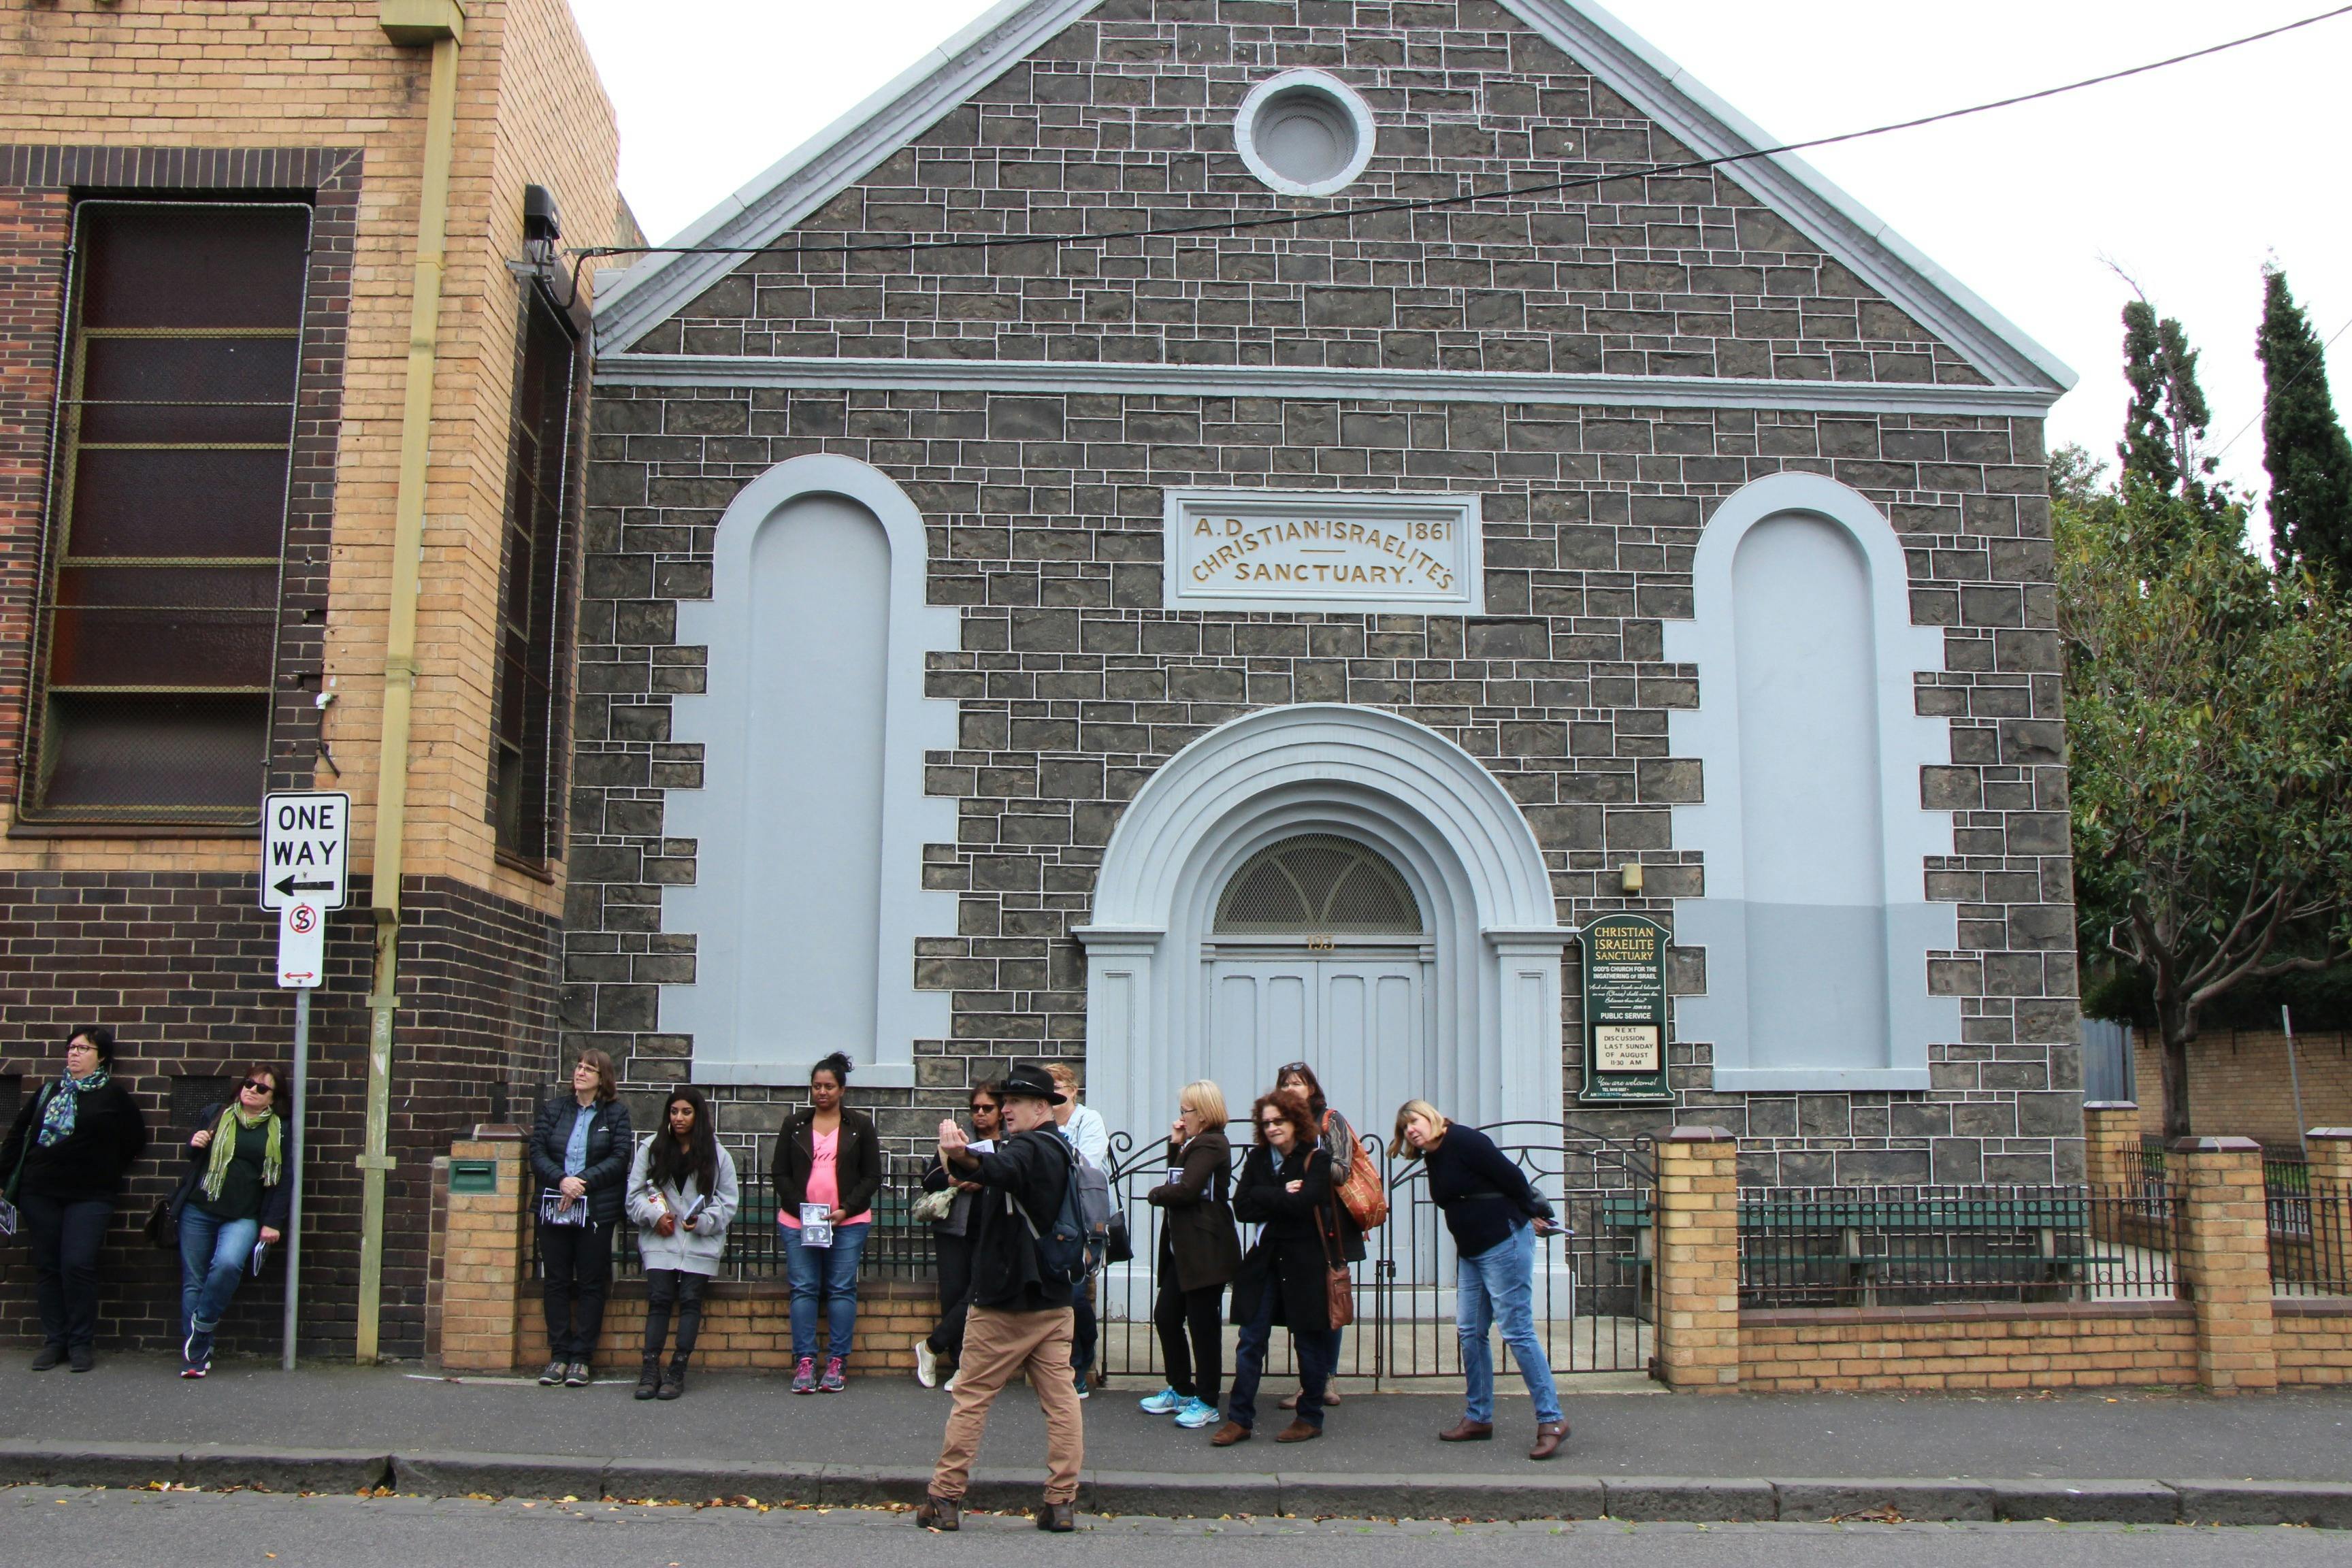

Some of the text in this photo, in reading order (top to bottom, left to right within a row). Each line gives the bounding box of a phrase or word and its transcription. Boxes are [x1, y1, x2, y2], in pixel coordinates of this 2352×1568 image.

[1406, 521, 1452, 542] 1861
[1234, 563, 1414, 585] SANCTUARY.
[278, 805, 335, 831] ONE
[273, 840, 338, 866] WAY
[1594, 927, 1654, 937] CHRISTIAN
[1307, 934, 1335, 951] 193
[1595, 938, 1654, 950] ISRAELITE
[1595, 951, 1654, 960] SANCTUARY
[1596, 1075, 1612, 1087] You
[1624, 1077, 1658, 1086] welcome!
